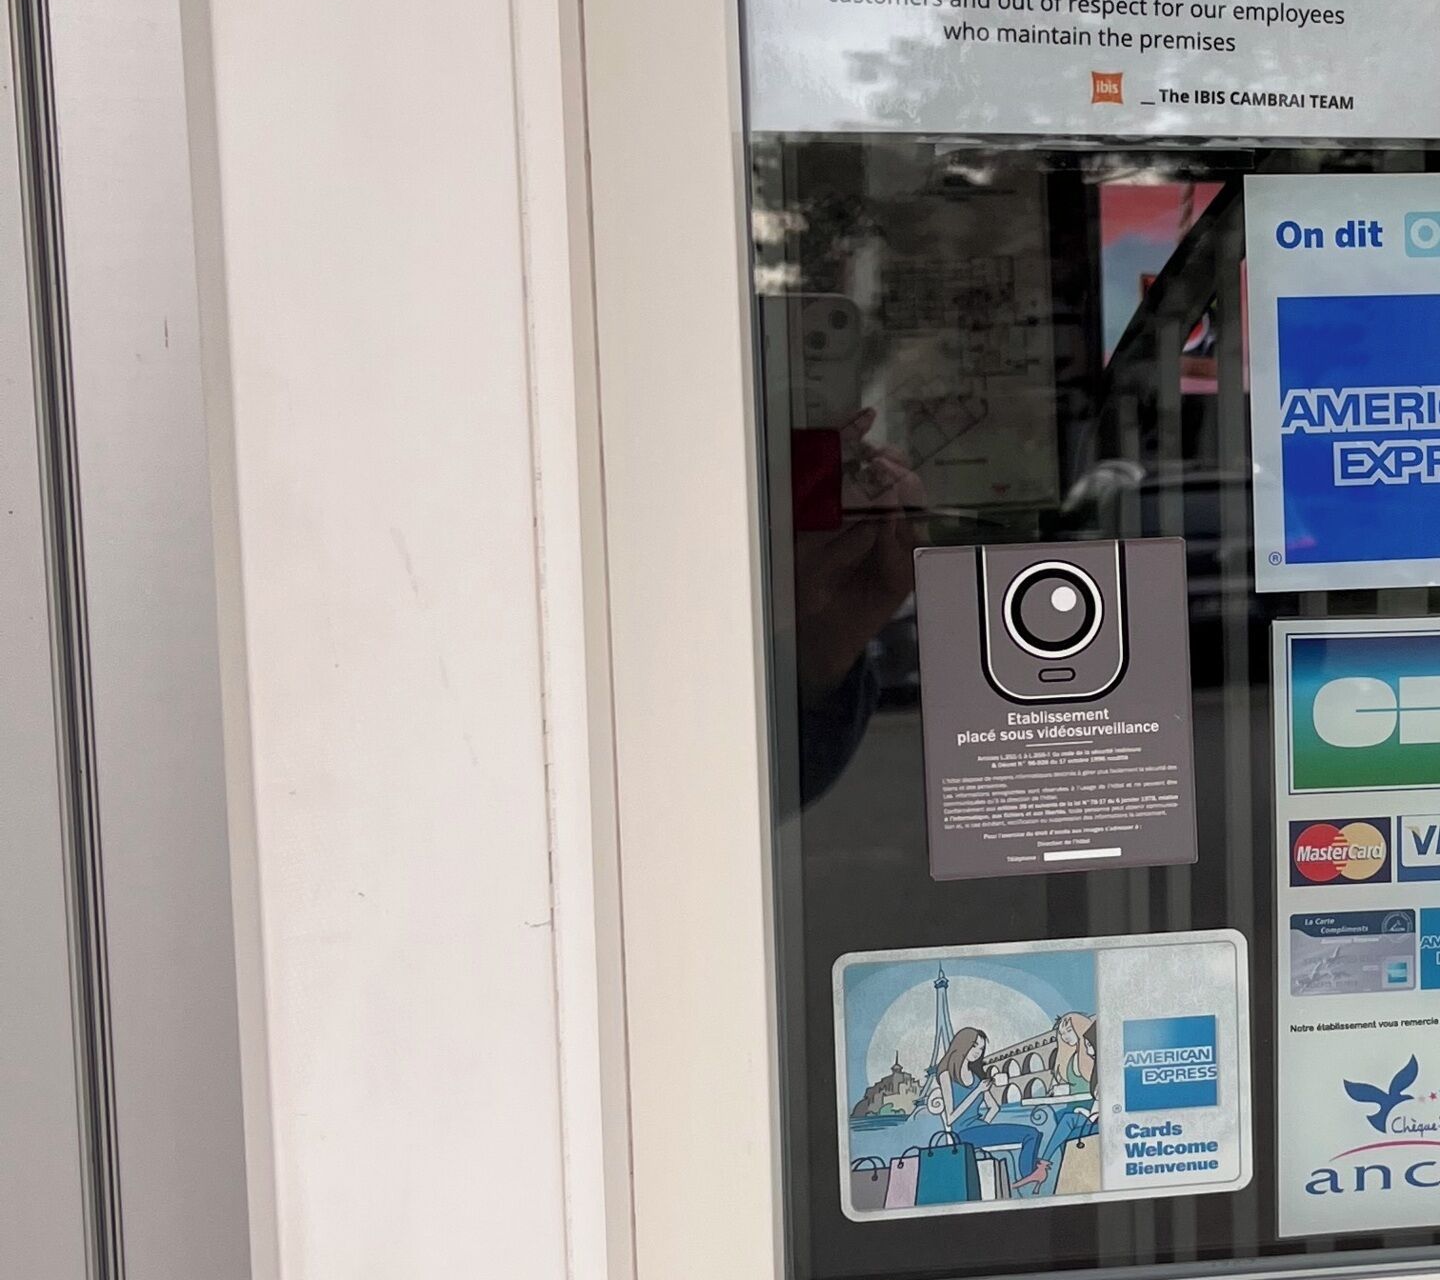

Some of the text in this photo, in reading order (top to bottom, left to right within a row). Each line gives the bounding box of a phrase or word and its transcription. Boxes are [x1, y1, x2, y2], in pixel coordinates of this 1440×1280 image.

[1069, 0, 1147, 19] respect
[1191, 4, 1226, 18] our
[1233, 3, 1344, 28] employees
[944, 21, 1235, 53] who maintain the premises
[1095, 79, 1119, 97] ibis
[1159, 89, 1353, 109] The IBIS CAMBRAI TEAM
[1276, 221, 1323, 249] On
[1335, 220, 1383, 248] dit
[1007, 708, 1110, 725] Etablissement
[957, 721, 1160, 746] placé sous vidéosurveillance
[1297, 842, 1383, 862] MasterCard
[1125, 1047, 1212, 1066] AMERICAN
[1143, 1065, 1218, 1084] EXPRESS
[1125, 1122, 1183, 1139] Cards
[1125, 1139, 1218, 1159] Welcome
[1125, 1158, 1219, 1176] Bienvenue
